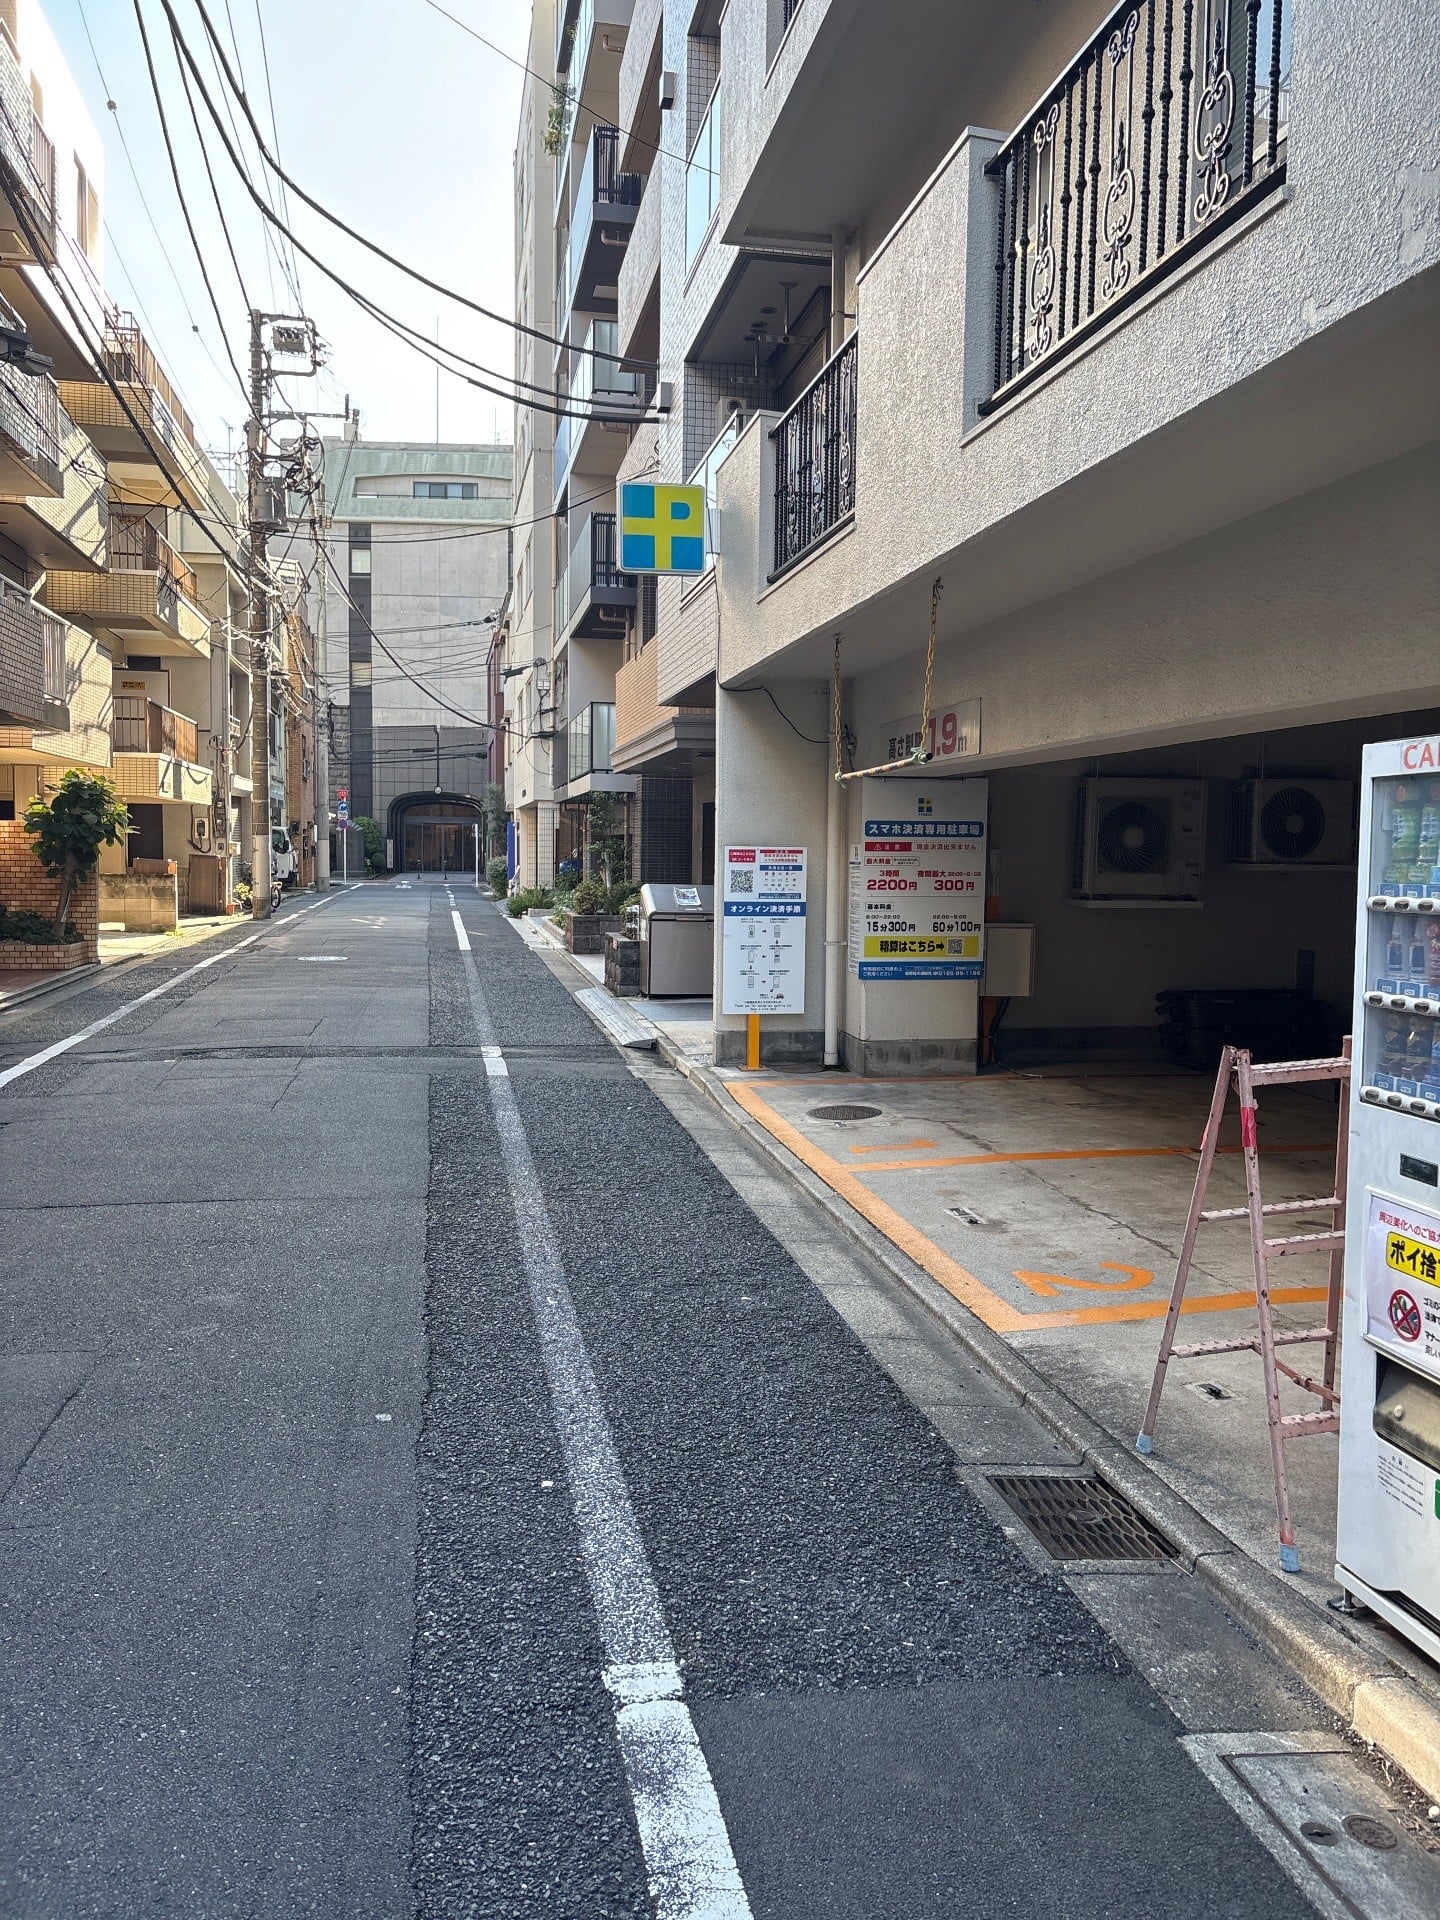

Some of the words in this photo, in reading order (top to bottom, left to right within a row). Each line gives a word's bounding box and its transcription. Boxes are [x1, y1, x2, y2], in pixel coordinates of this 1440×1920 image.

[1403, 742, 1440, 769] CA
[869, 824, 980, 835] スマホ決済専用駐車場
[867, 879, 917, 891] 2200円
[934, 880, 975, 891] 300円
[730, 905, 801, 913] オンライン決済手順
[1390, 1240, 1440, 1280] ポイ捨
[1012, 1261, 1154, 1297] 2
